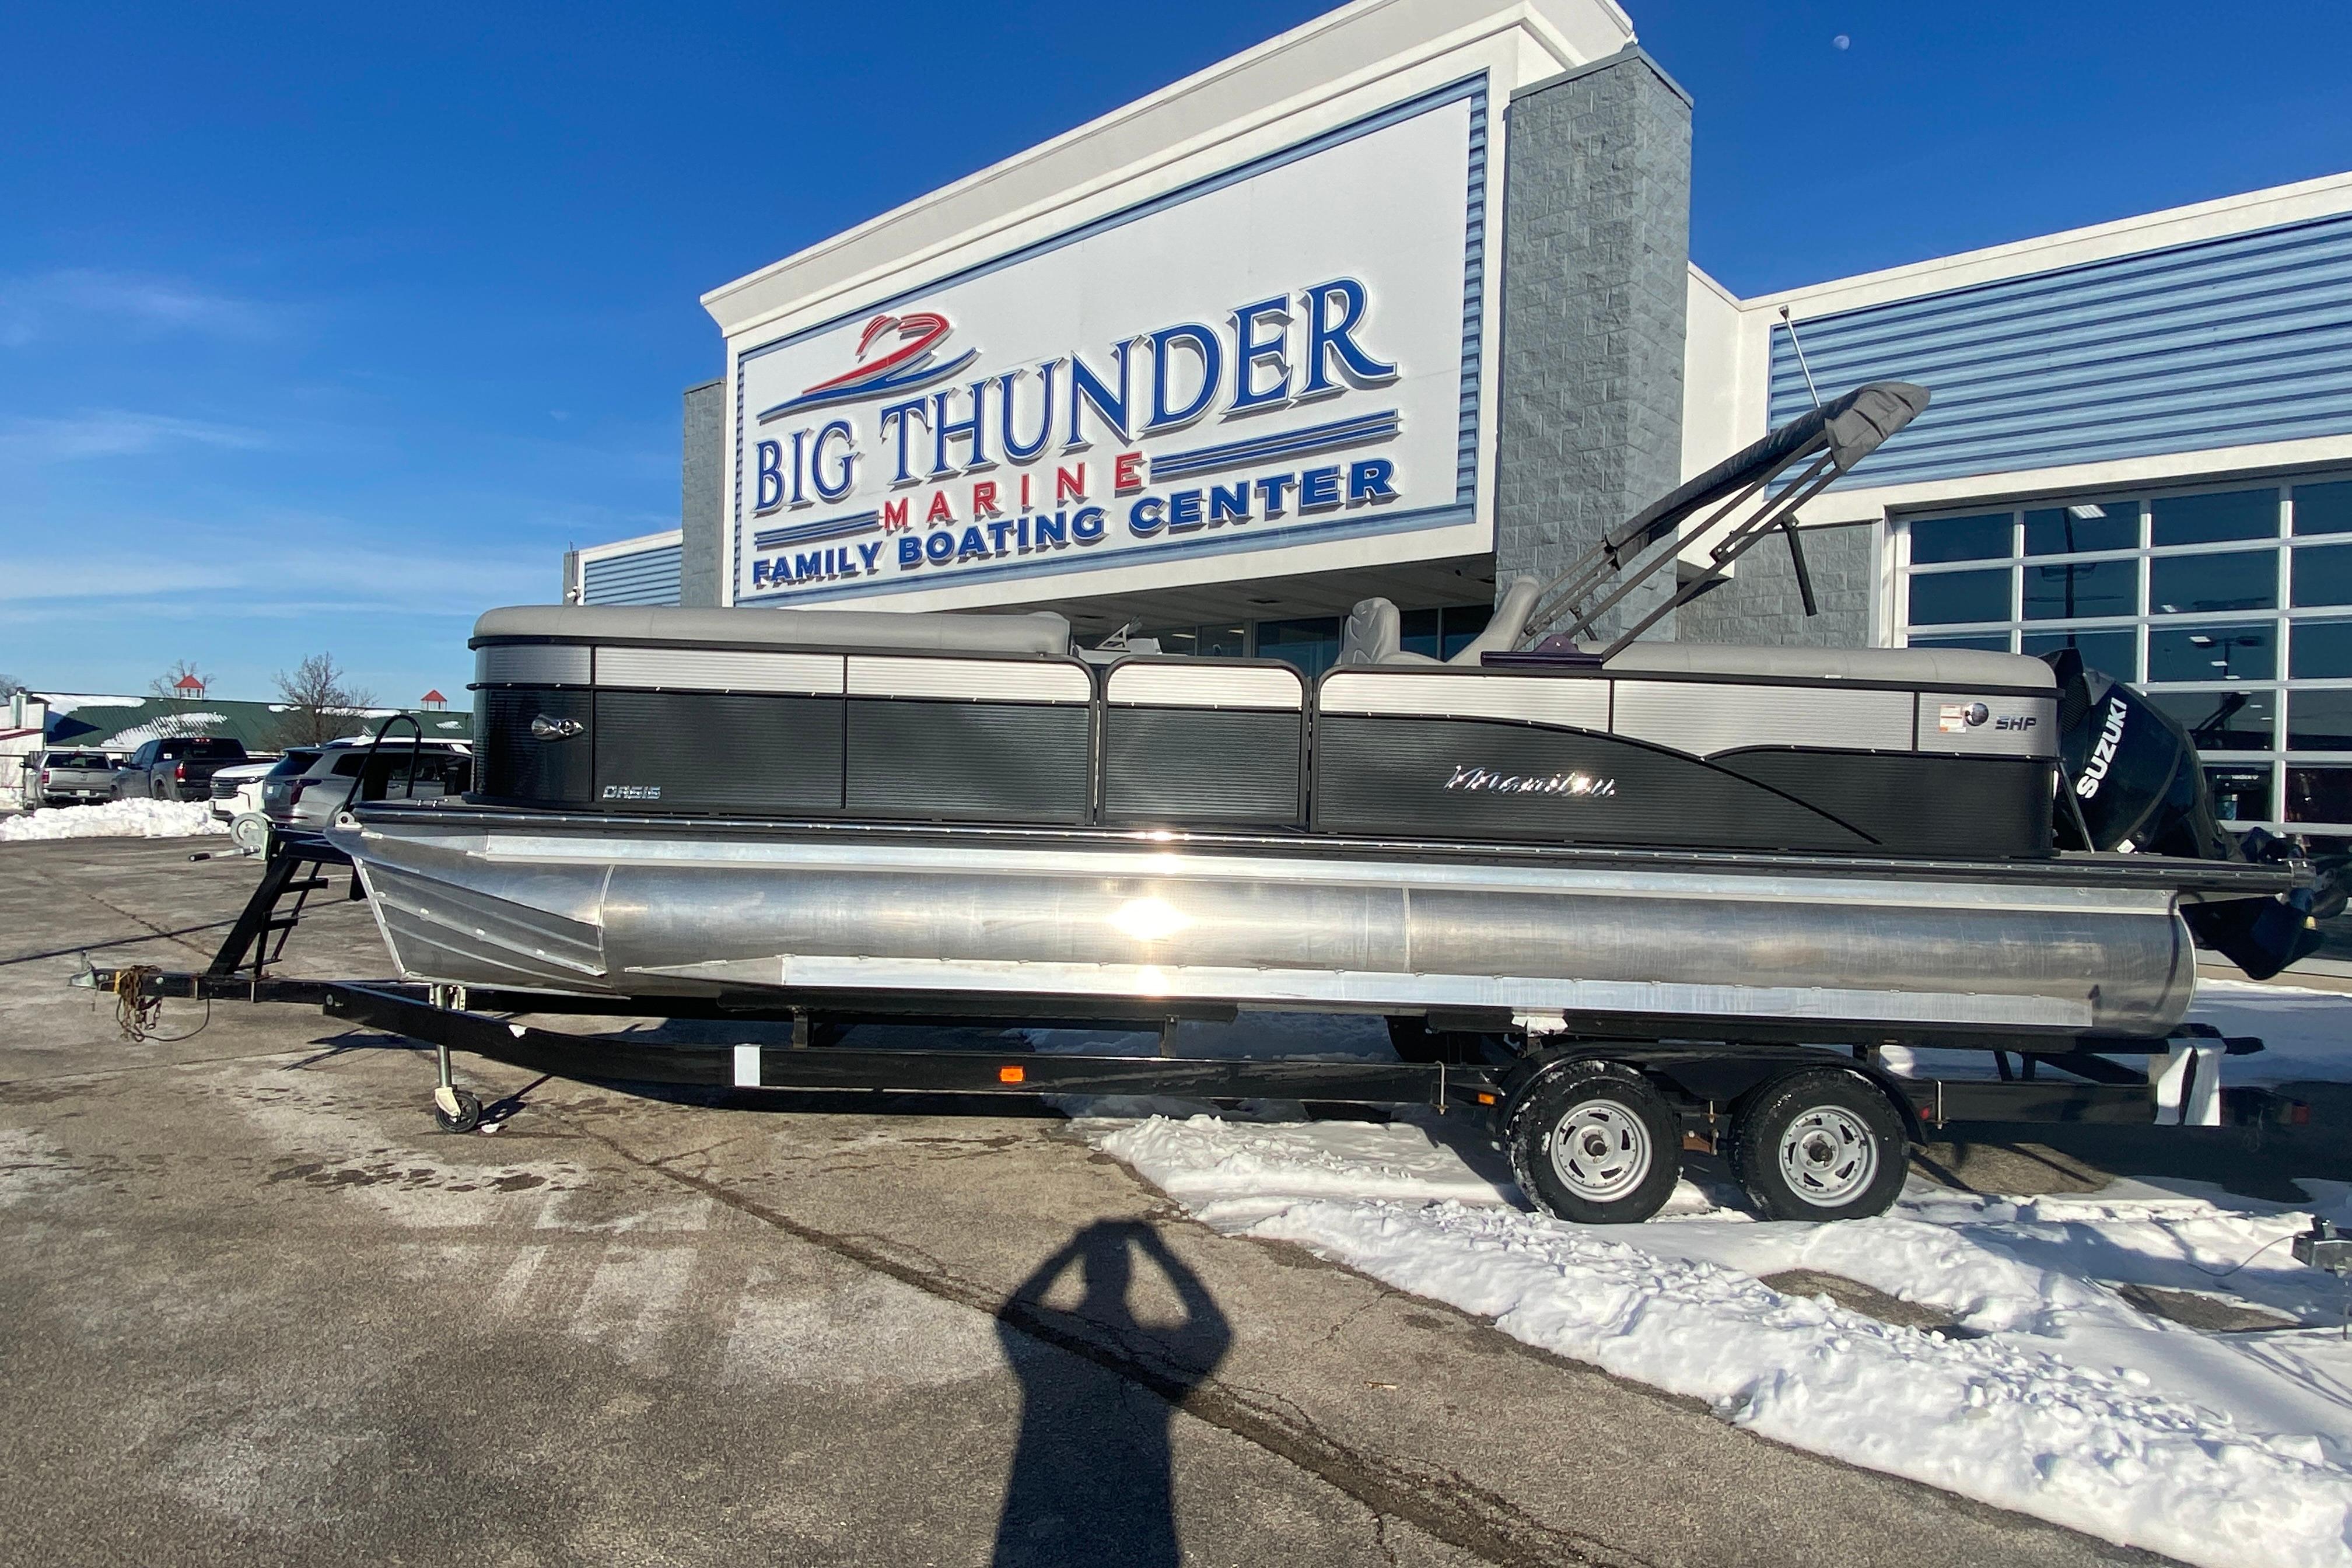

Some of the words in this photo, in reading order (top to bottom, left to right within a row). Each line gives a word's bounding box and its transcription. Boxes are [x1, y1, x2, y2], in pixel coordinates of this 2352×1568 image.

[751, 418, 859, 513] BIG
[879, 275, 1398, 485] THUNDER
[752, 540, 883, 583] FAMILY
[898, 506, 1105, 565] BOATING
[1128, 459, 1395, 532] CENTER
[884, 450, 1143, 530] MARINE
[1995, 716, 2037, 732] SHP
[2076, 697, 2127, 799] SUZUKI
[603, 785, 661, 799] OASIS
[1443, 765, 1616, 798] Manitu
